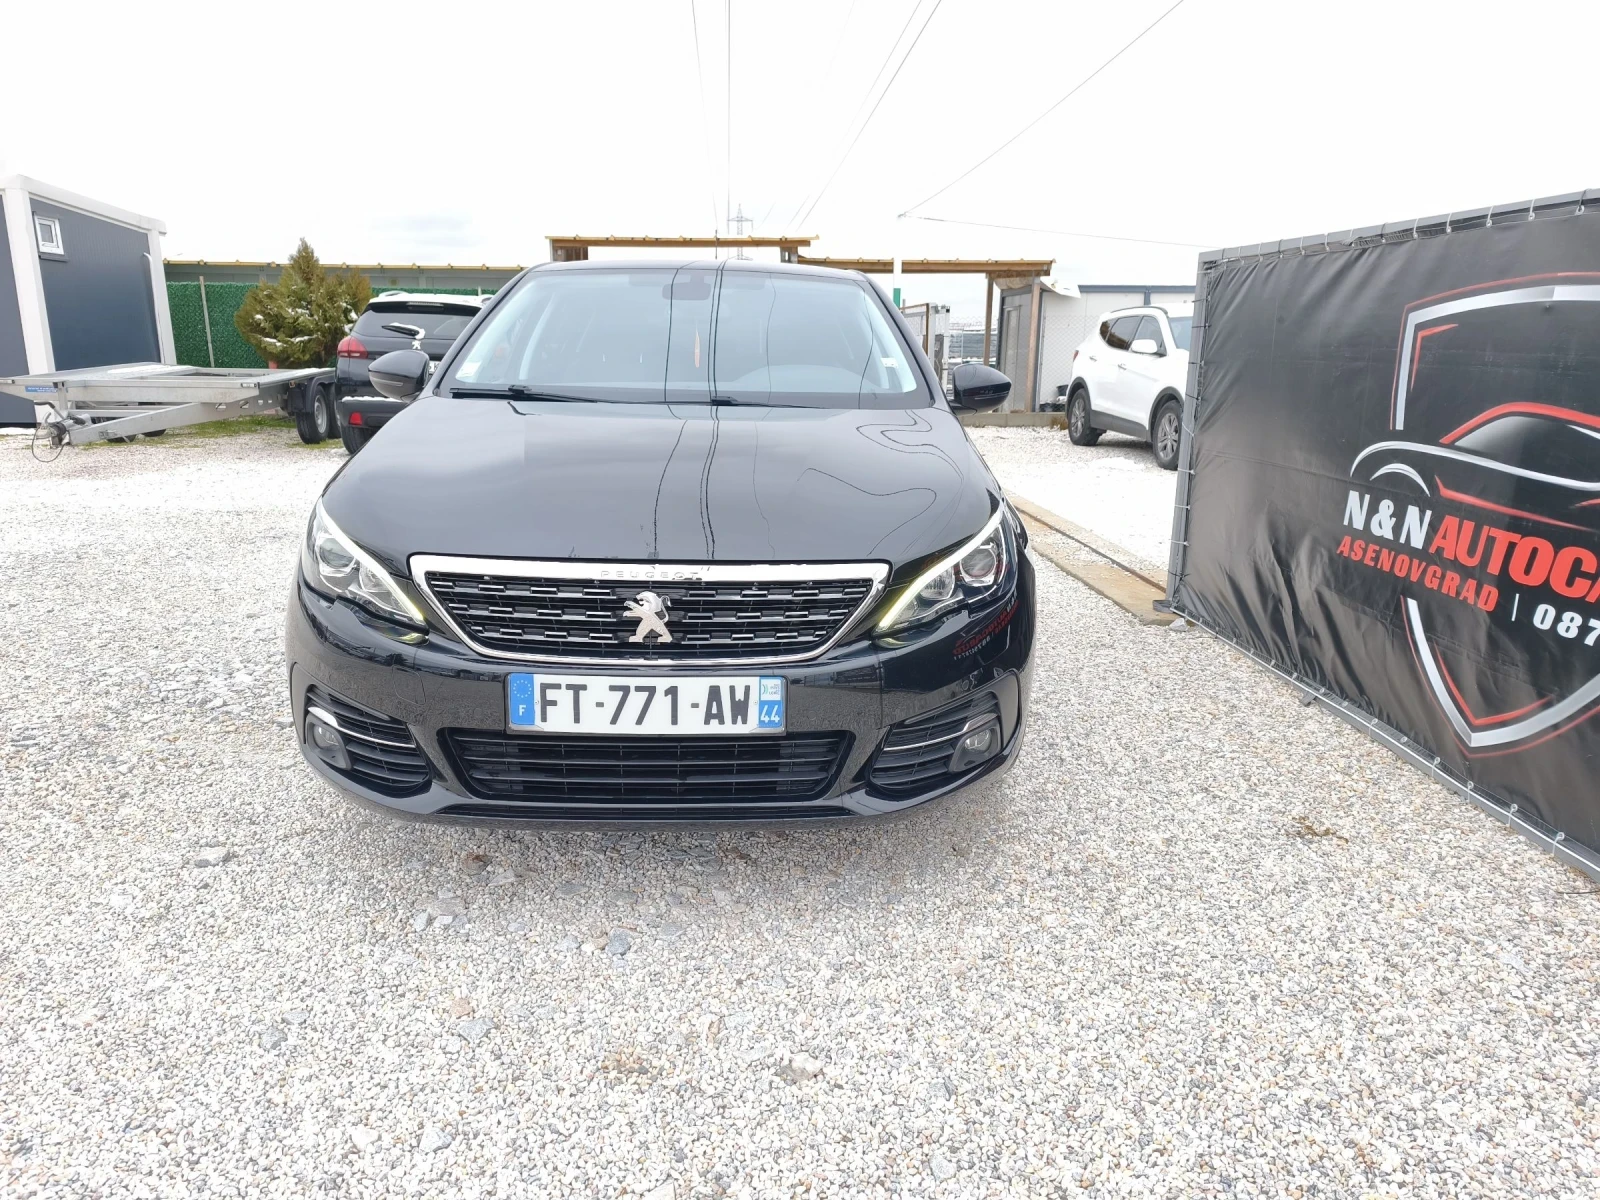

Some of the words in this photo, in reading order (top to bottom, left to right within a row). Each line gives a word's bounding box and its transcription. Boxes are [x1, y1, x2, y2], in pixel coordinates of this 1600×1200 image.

[1343, 489, 1432, 549] N&N
[600, 570, 700, 580] PEUGEOT
[1336, 535, 1499, 612] ASENOVGRAD
[518, 704, 527, 716] F
[539, 681, 751, 726] FT-771-AW
[760, 704, 780, 723] 44
